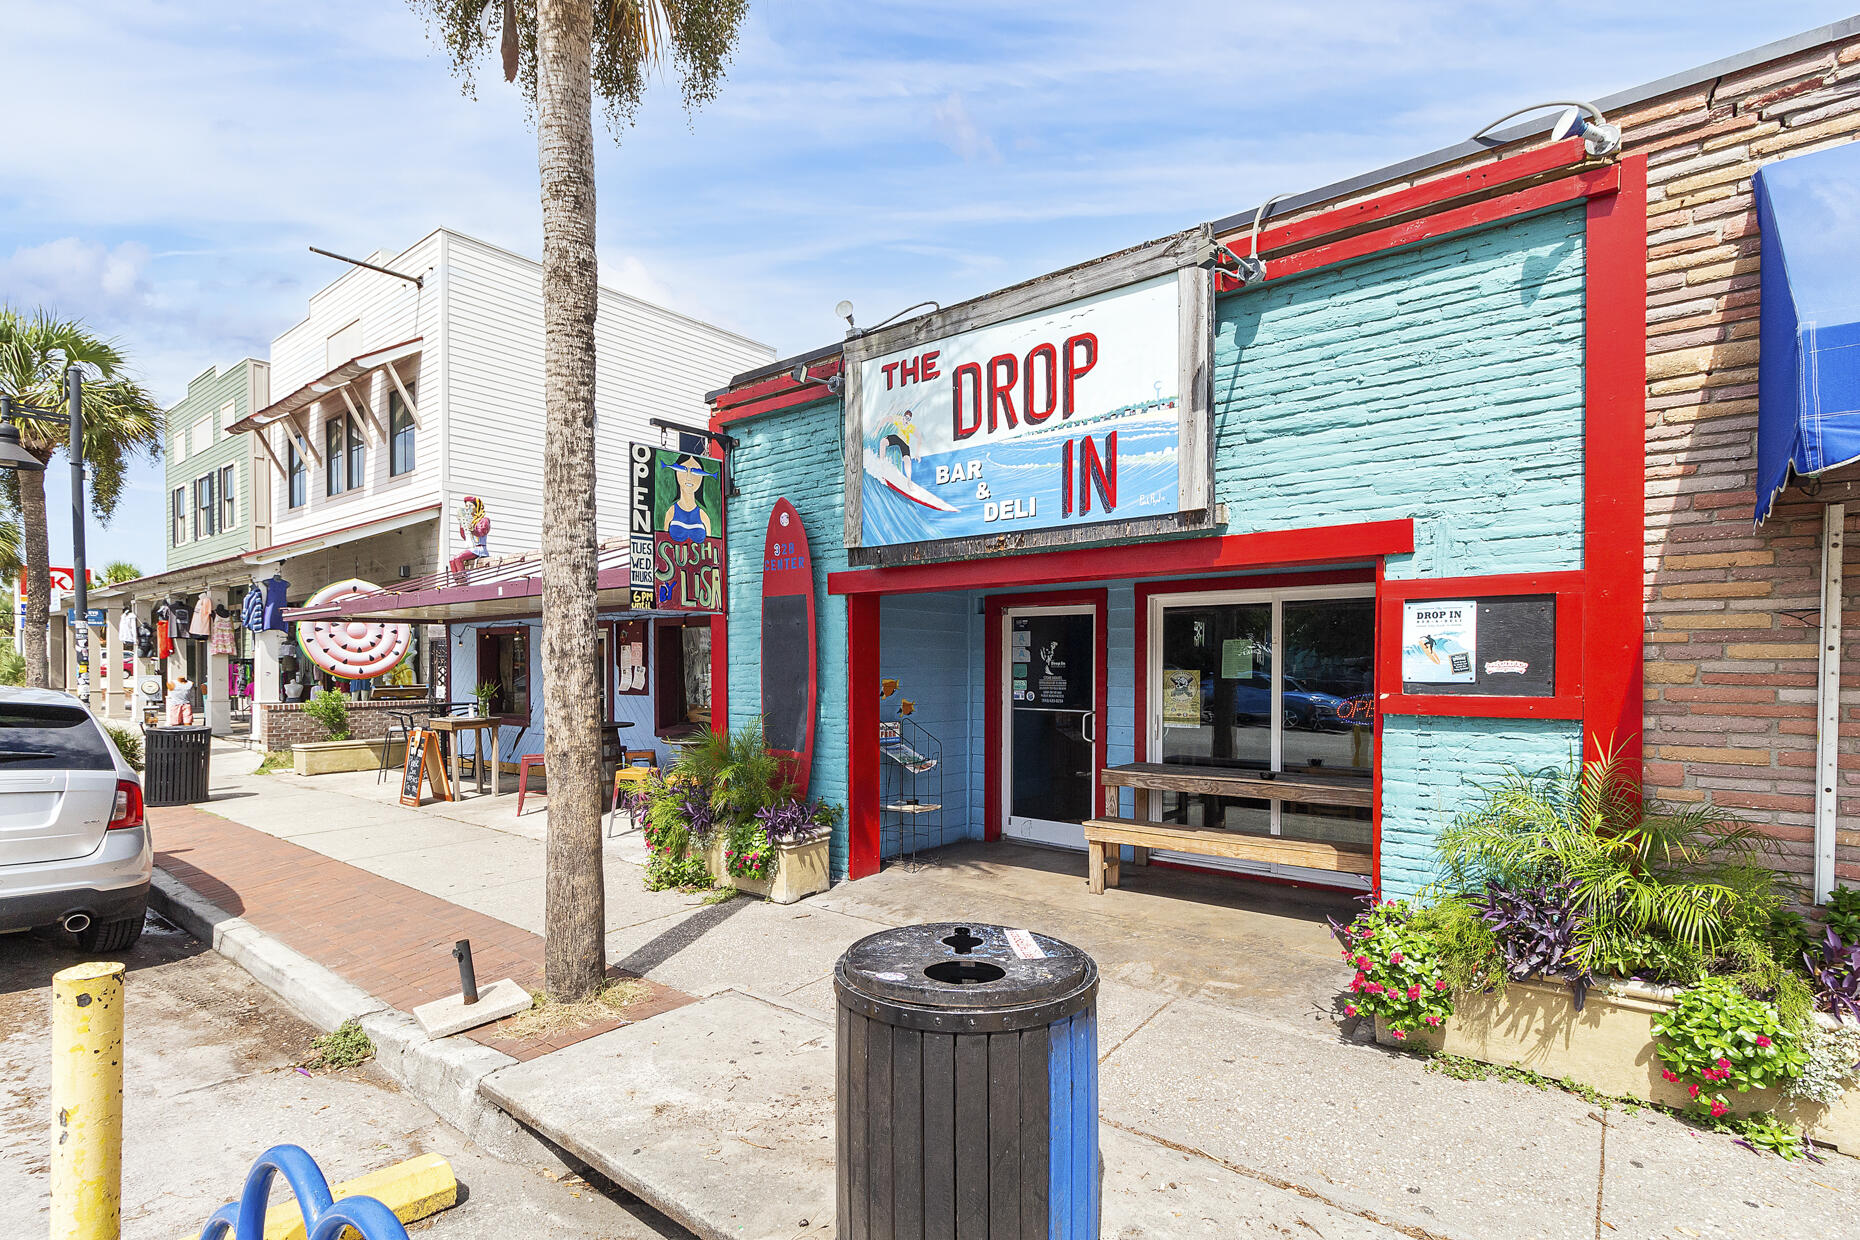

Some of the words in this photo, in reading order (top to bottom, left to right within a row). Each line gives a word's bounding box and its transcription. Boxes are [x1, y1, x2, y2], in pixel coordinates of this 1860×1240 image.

[881, 350, 941, 391] THE
[953, 332, 1098, 441] DROP
[936, 460, 983, 486] BAR
[1062, 430, 1118, 519] IN
[632, 443, 651, 533] OPEN
[976, 482, 992, 501] &
[984, 496, 1037, 523] DELI
[655, 541, 720, 582] SUSHI
[764, 556, 805, 571] CENTER
[50, 576, 69, 591] K
[659, 581, 677, 603] BY
[680, 565, 722, 610] LISA
[1416, 611, 1446, 620] DROP
[1449, 610, 1462, 619] IN
[1336, 699, 1375, 719] OPE
